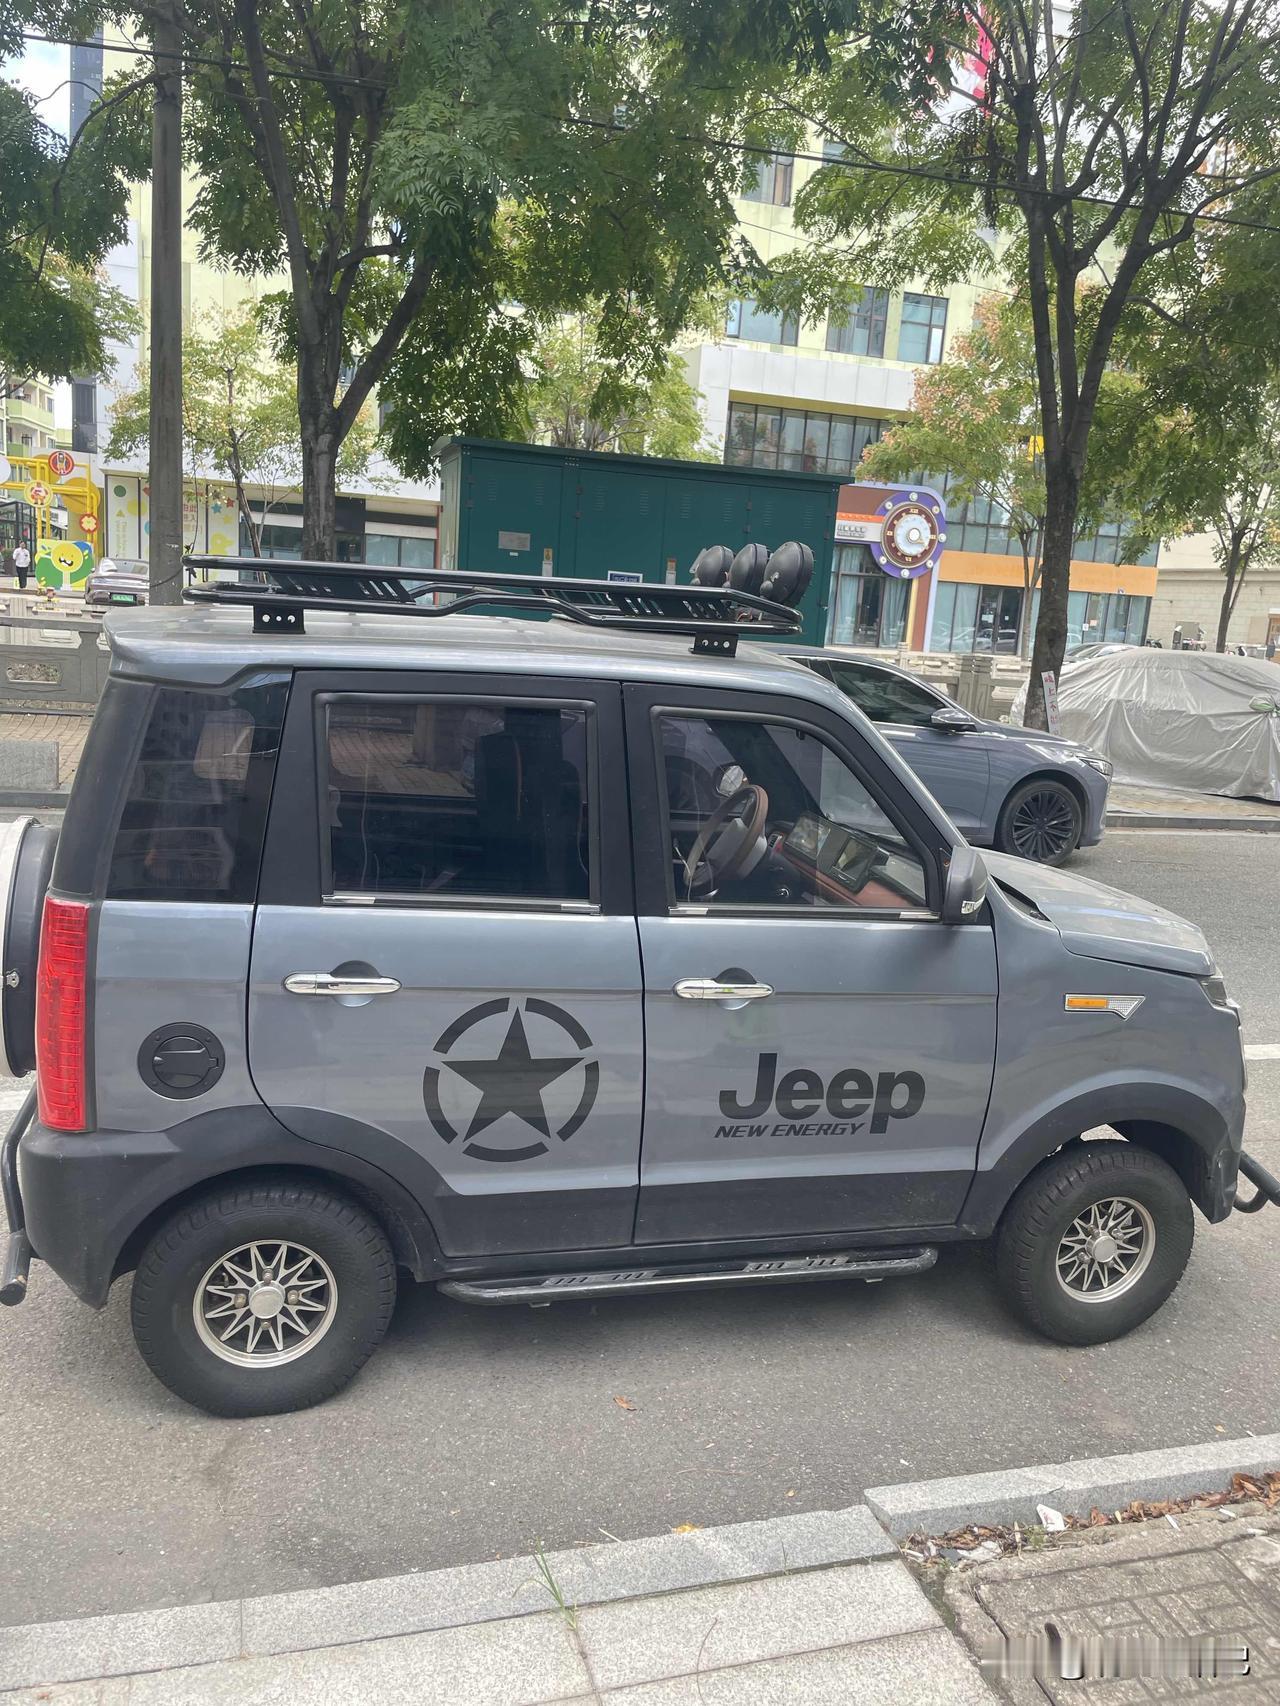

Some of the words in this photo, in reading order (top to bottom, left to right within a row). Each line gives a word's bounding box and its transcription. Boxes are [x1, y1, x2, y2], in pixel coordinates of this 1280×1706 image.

[718, 1052, 926, 1134] Jeep
[714, 1124, 769, 1138] NEW
[770, 1122, 866, 1137] ENERGY
